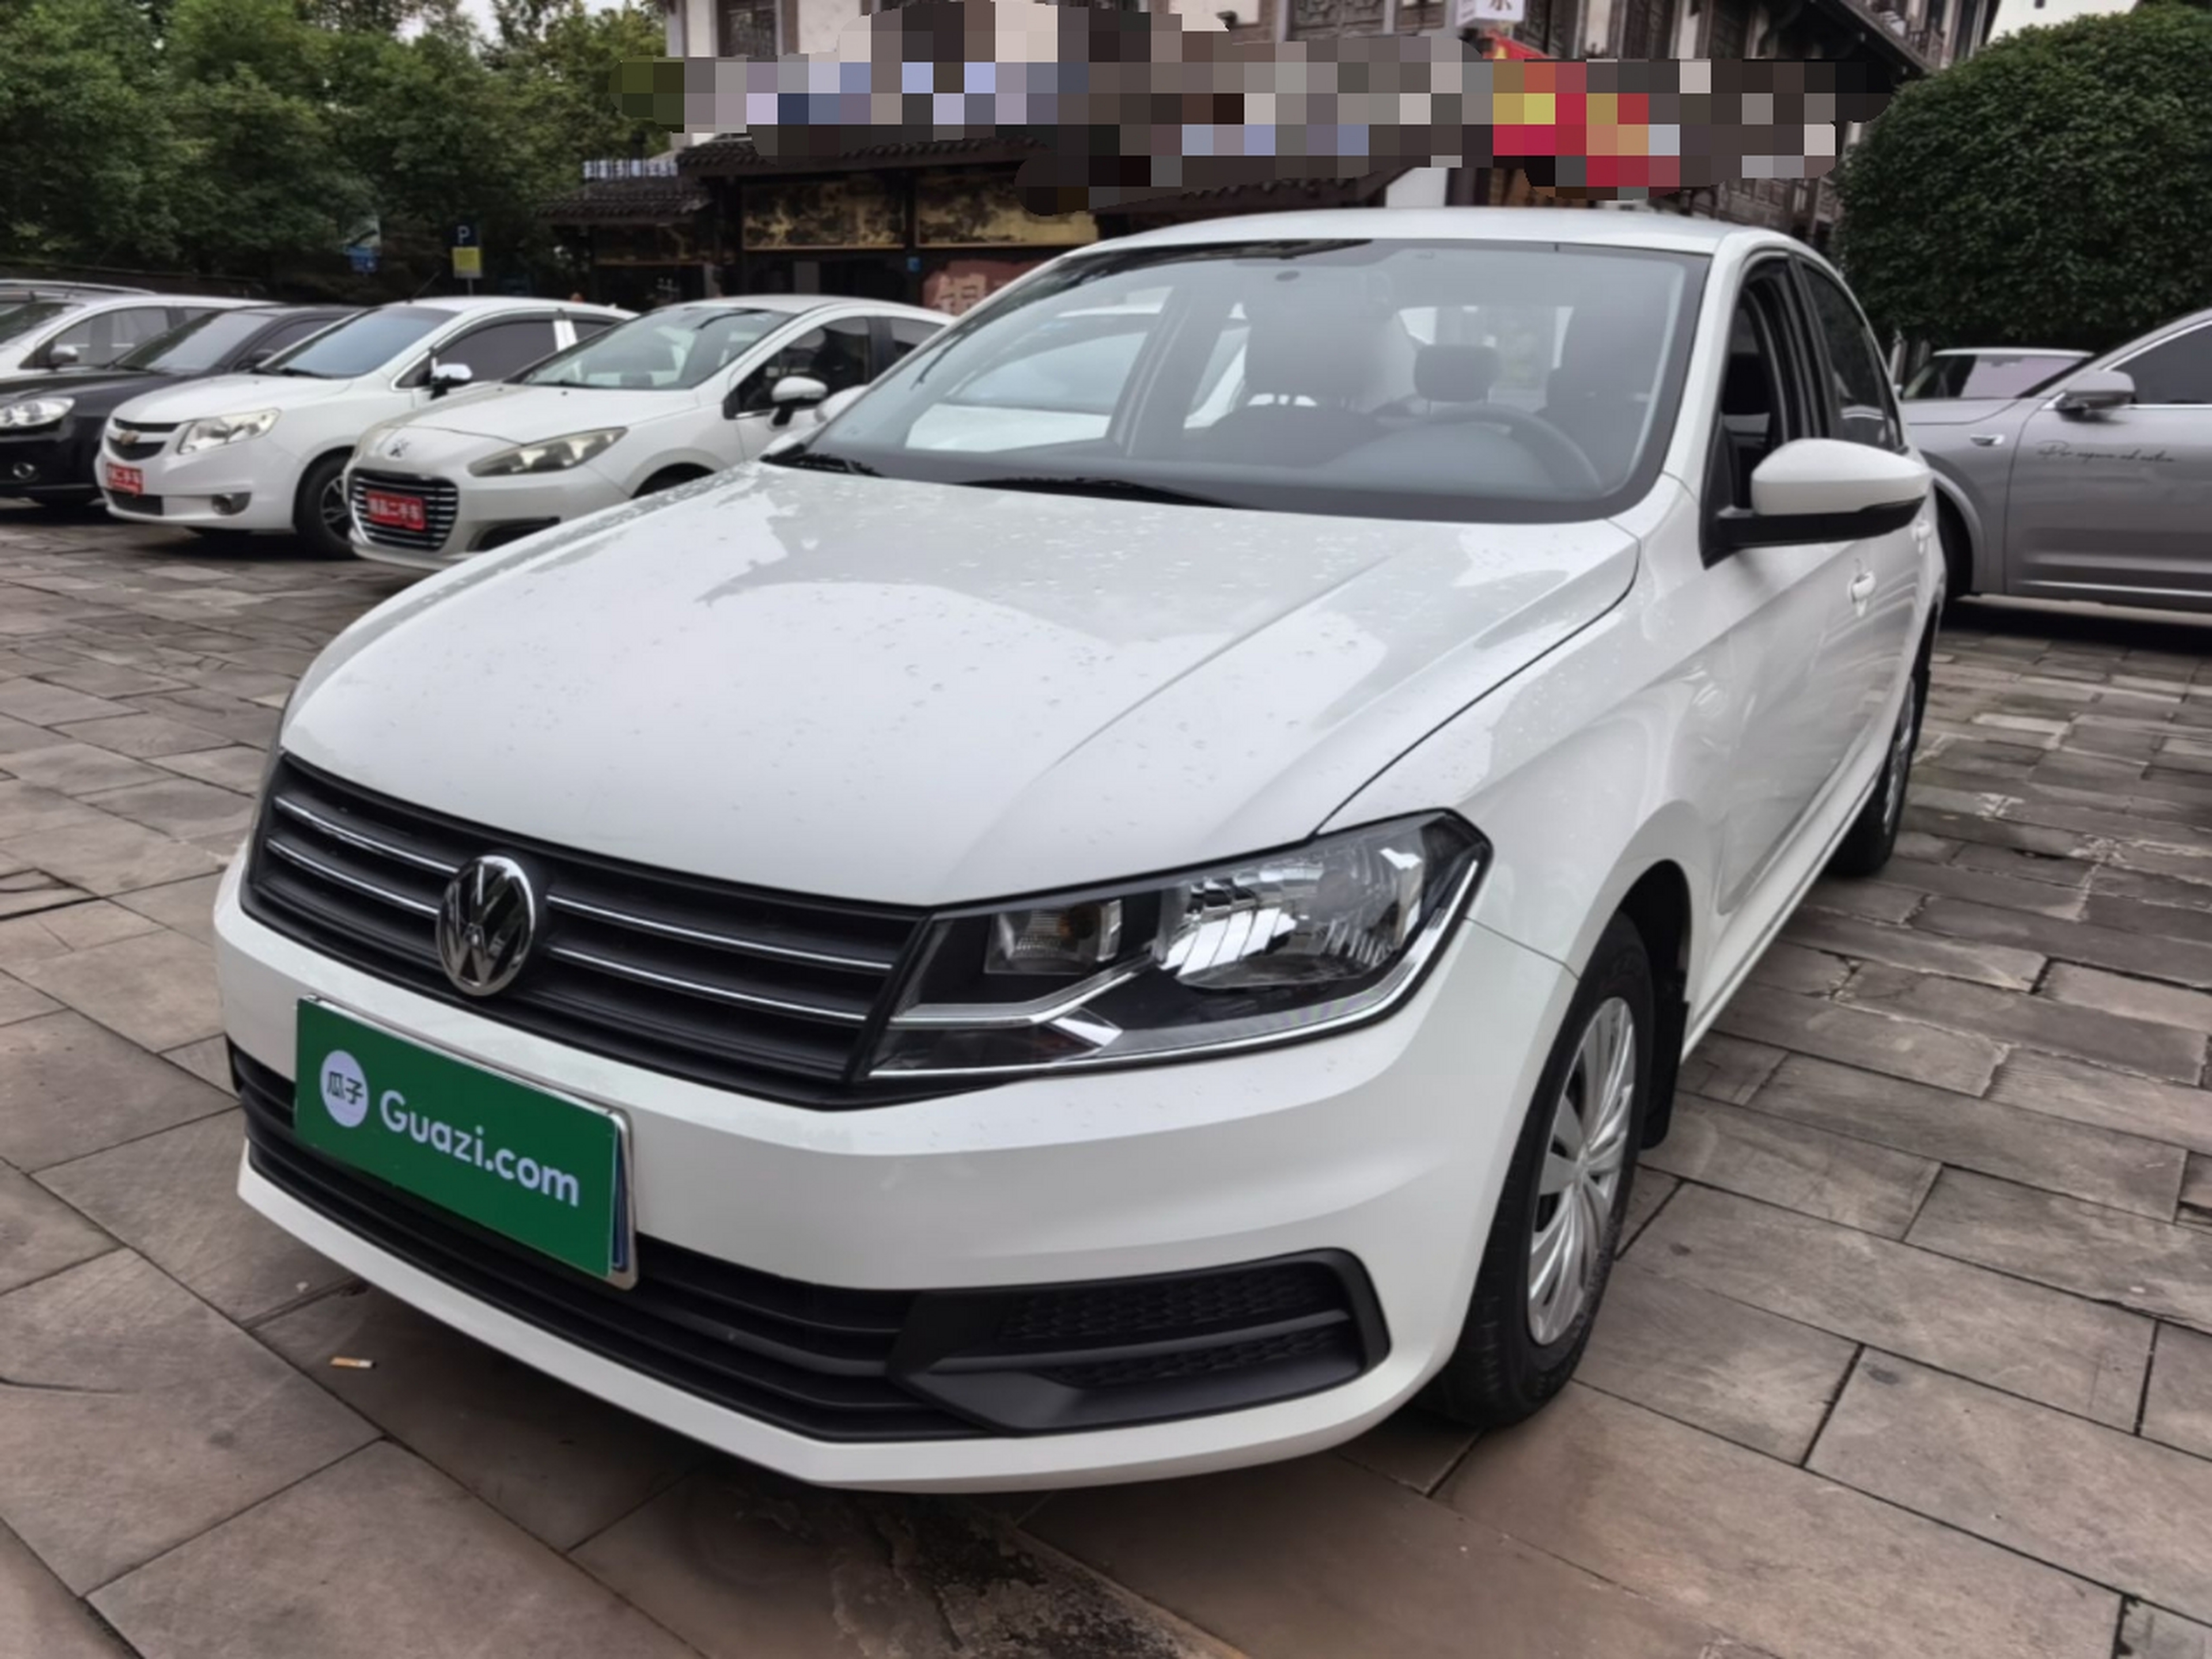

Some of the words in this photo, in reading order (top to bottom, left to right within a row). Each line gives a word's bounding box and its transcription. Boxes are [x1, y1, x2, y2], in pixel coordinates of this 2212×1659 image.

[458, 226, 470, 244] P
[327, 1071, 363, 1105] 瓜子
[380, 1090, 579, 1207] Guazi.com
